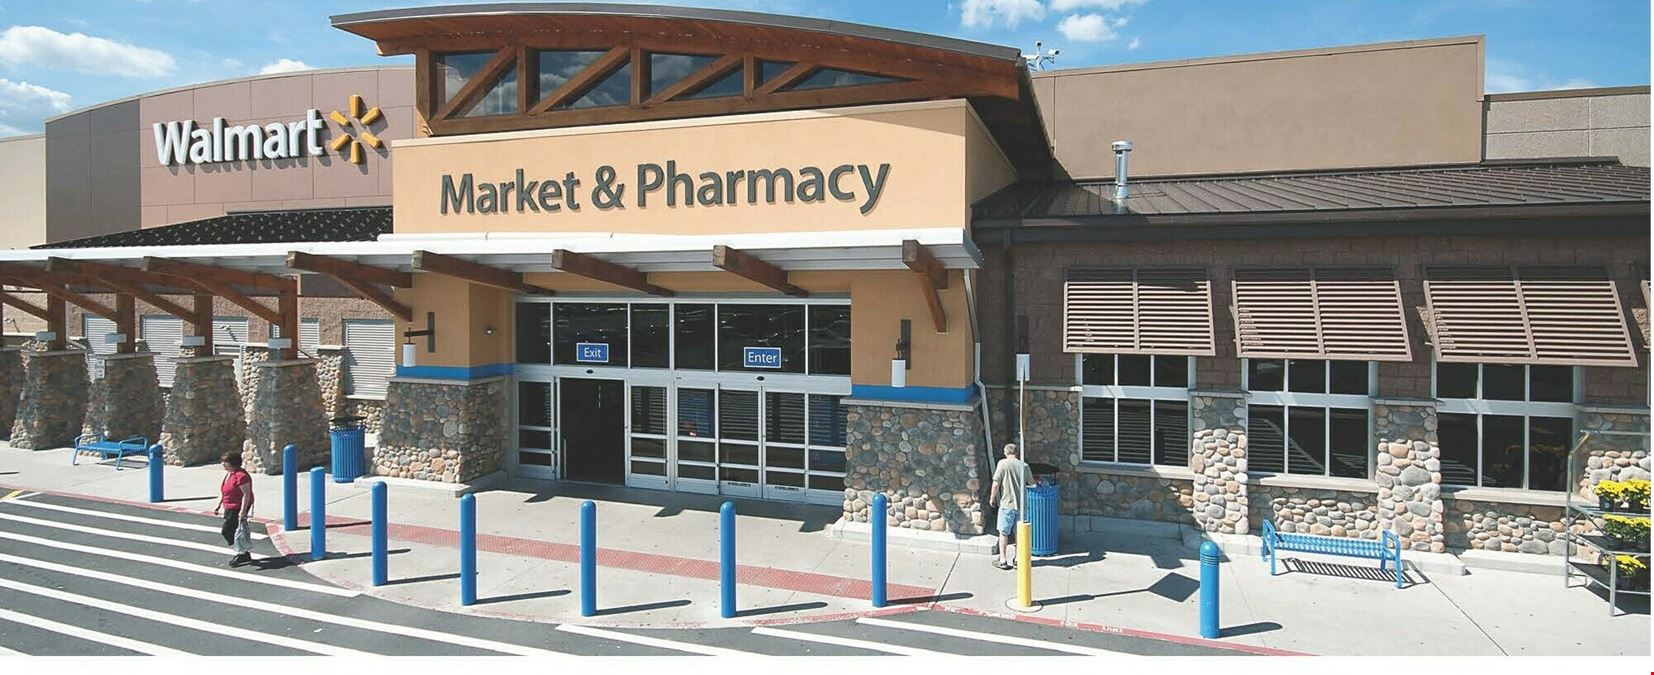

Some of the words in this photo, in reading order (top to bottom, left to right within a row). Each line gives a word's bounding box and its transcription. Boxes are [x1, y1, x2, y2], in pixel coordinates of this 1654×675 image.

[153, 108, 323, 166] Walmart
[440, 169, 580, 215] Market
[591, 165, 624, 209] &
[637, 160, 890, 215] Pharmacy
[584, 347, 602, 358] Exit
[748, 351, 777, 363] Enter
